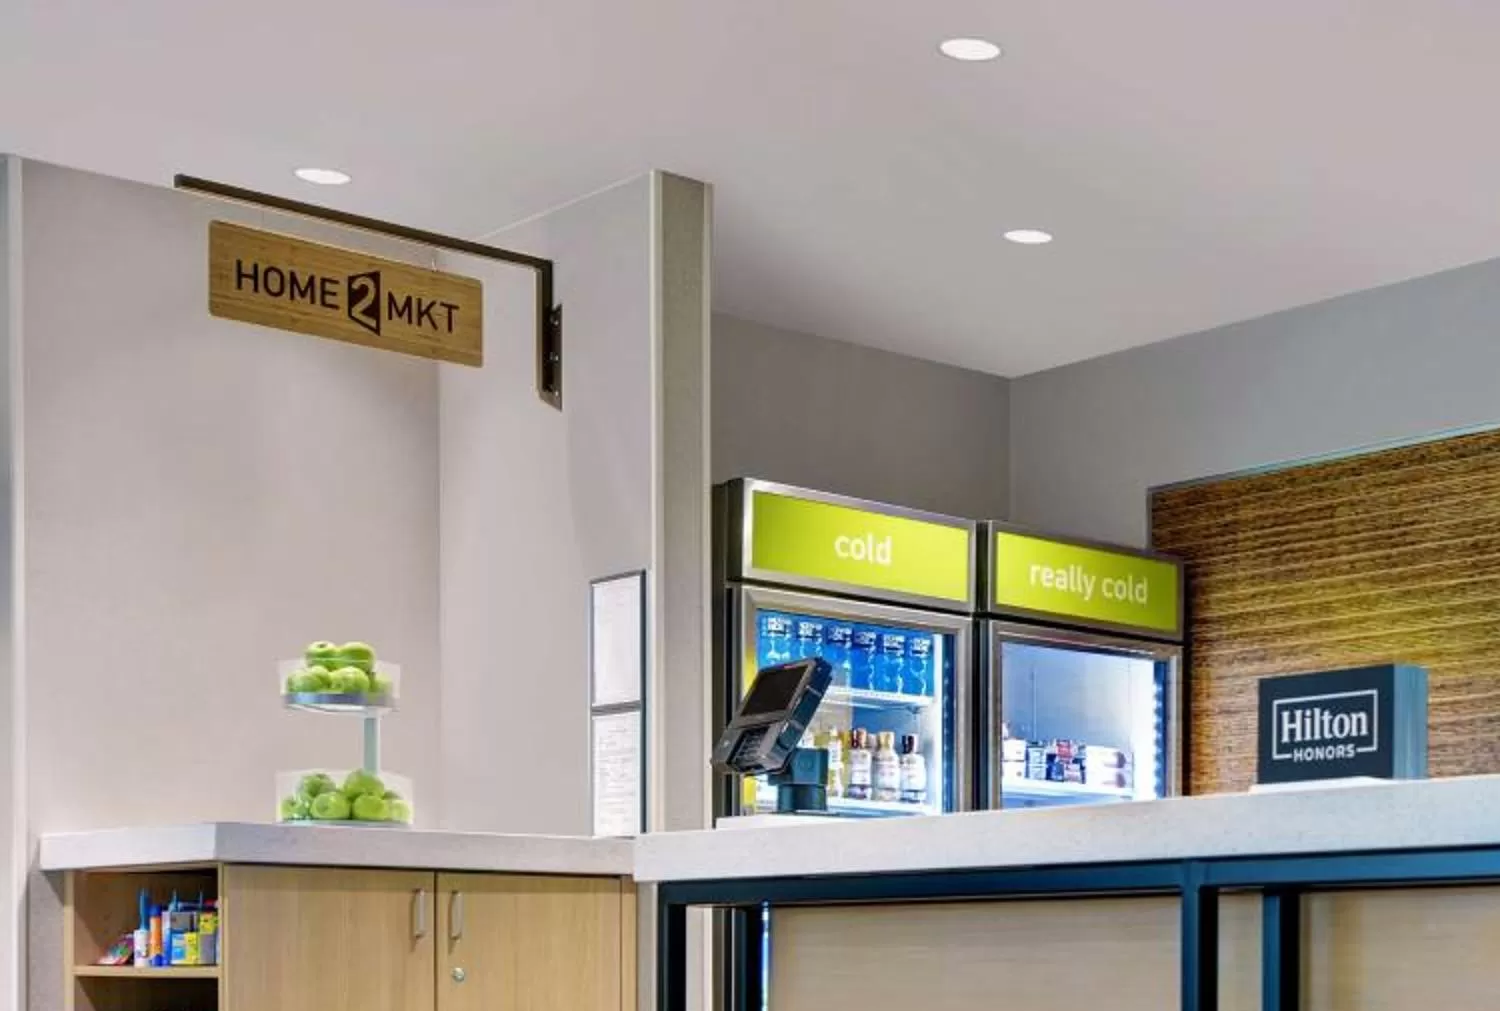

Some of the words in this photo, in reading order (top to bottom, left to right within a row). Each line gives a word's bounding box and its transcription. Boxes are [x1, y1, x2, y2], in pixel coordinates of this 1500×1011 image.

[834, 531, 892, 566] cold
[1028, 562, 1096, 601] really
[1101, 575, 1149, 606] cold
[1280, 708, 1368, 744] Hilton
[1293, 744, 1356, 762] HONORS
